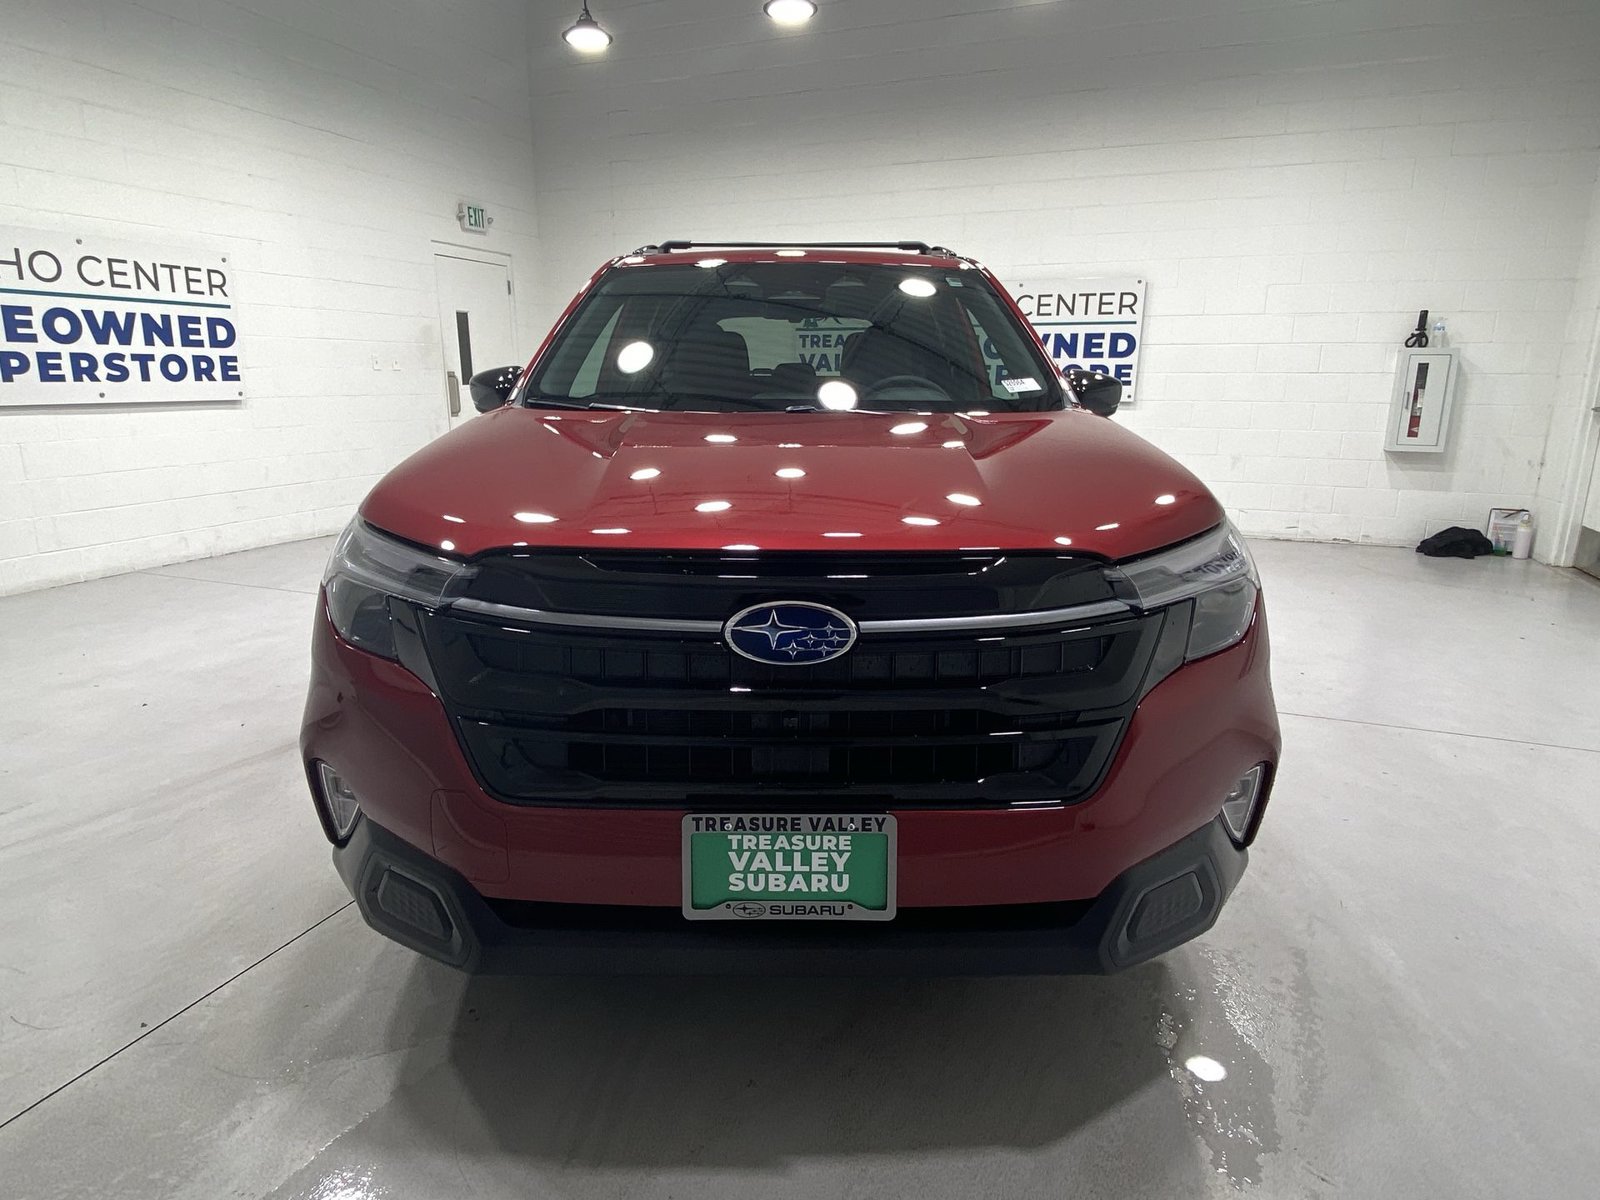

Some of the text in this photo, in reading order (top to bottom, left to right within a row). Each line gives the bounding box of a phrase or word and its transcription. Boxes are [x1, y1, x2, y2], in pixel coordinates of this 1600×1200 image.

[467, 206, 485, 229] EXIT
[76, 255, 229, 298] CENTER
[1016, 292, 1138, 317] CENTER
[1, 304, 237, 349] EOWNED
[0, 350, 241, 383] PERSTORE
[691, 816, 887, 832] TREASURE VALLEY
[727, 835, 852, 850] TREASURE
[728, 851, 852, 872] VALLEY
[728, 873, 850, 892] SUBARU
[769, 905, 845, 916] SUBARU
